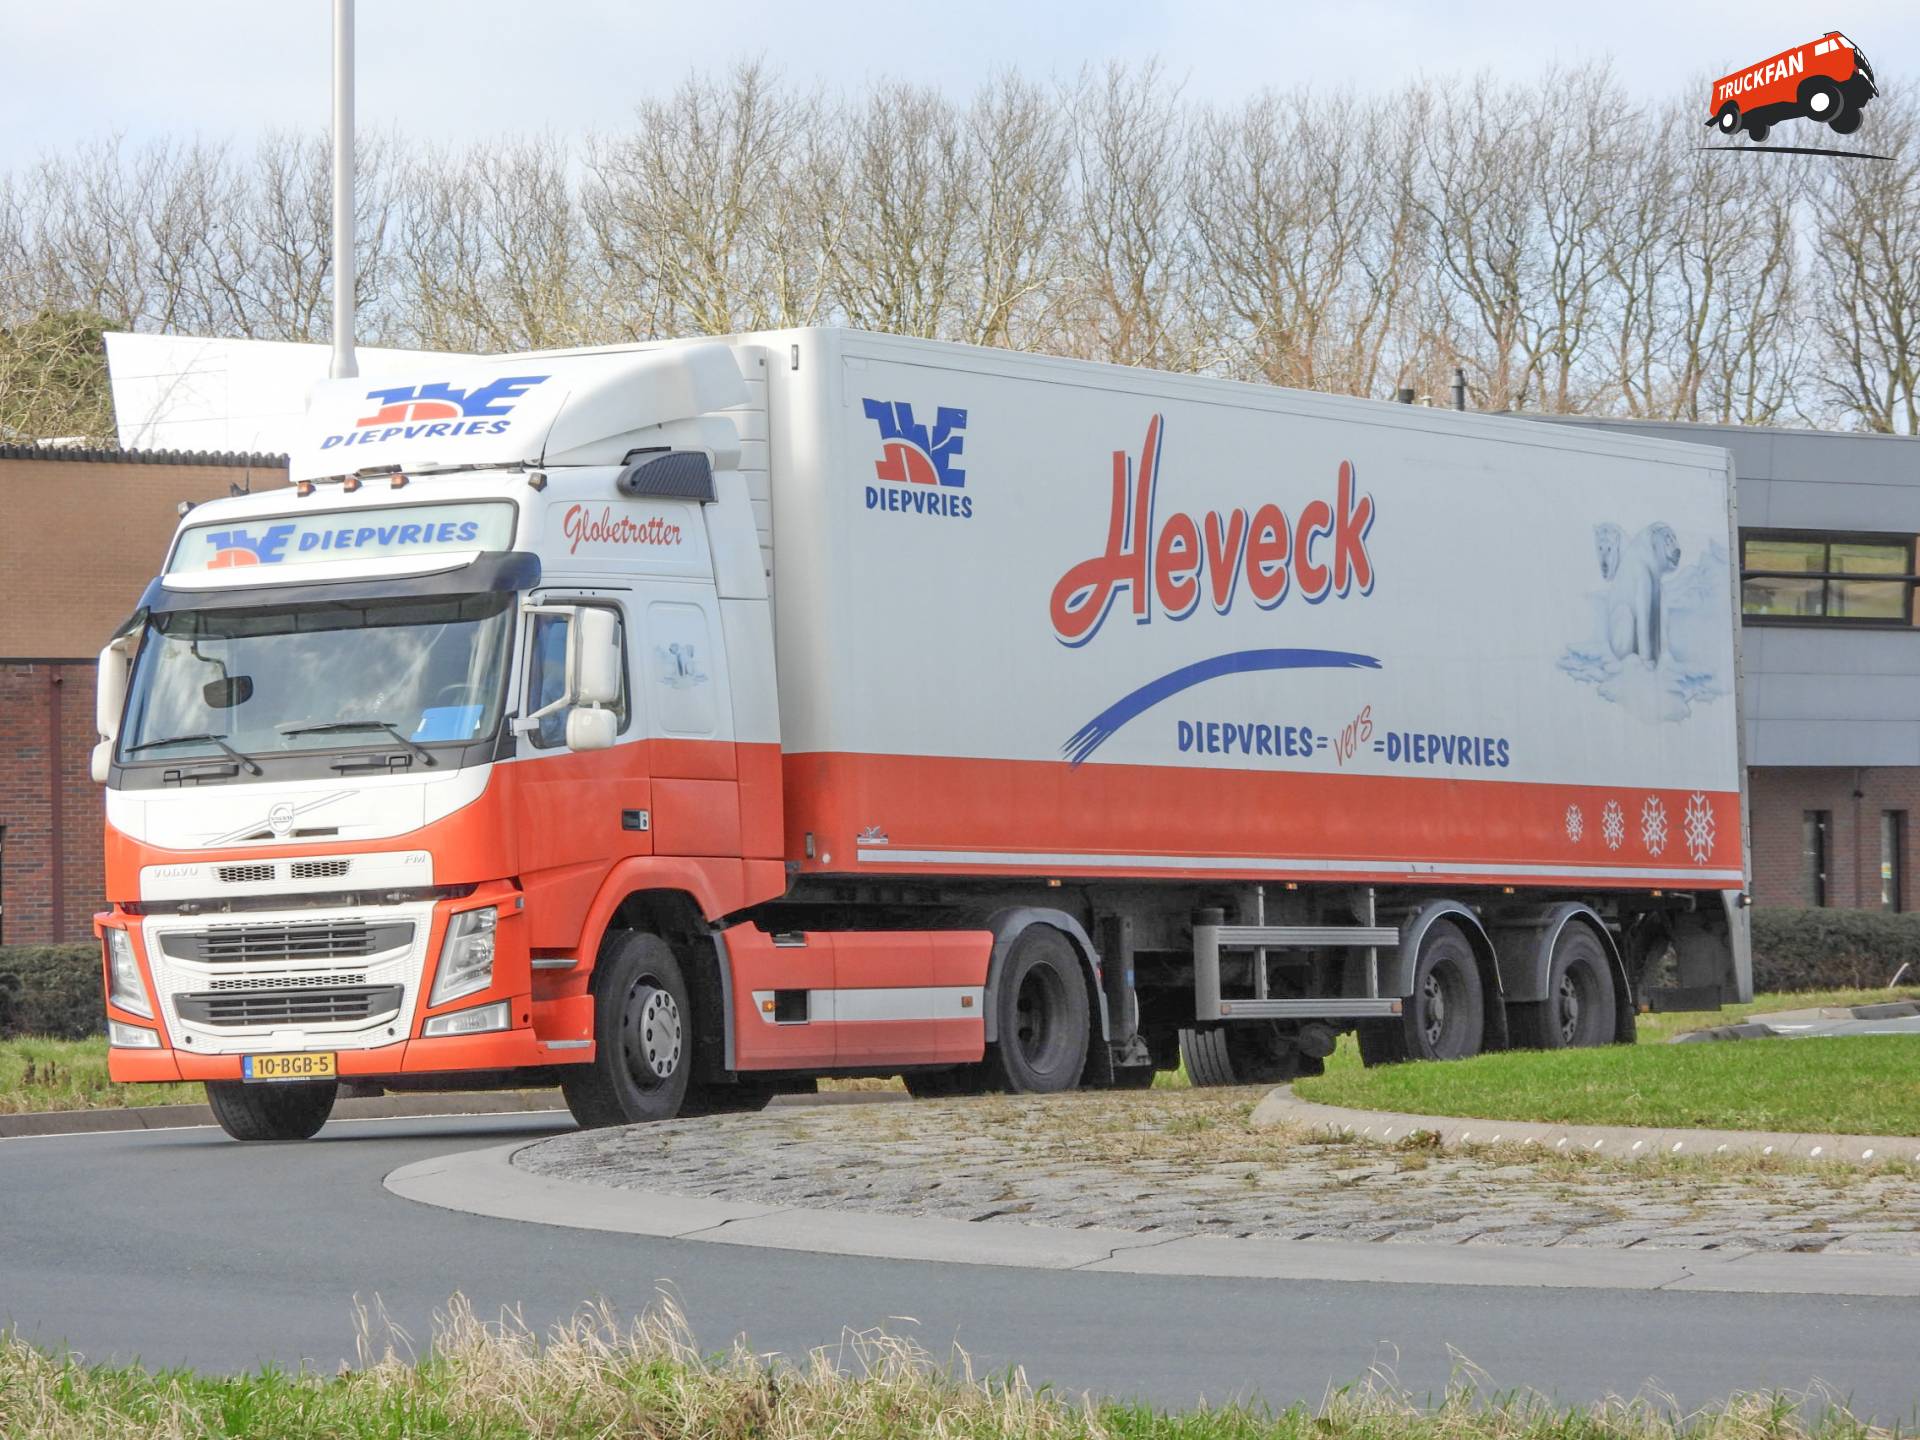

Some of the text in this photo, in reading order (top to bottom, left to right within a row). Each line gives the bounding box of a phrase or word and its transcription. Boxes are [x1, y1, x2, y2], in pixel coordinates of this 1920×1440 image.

[319, 420, 511, 450] DIEPVRIES
[865, 486, 973, 519] DIEPVRIES
[298, 521, 480, 551] DIEPVRIES
[563, 504, 682, 555] Globetrotter
[1050, 412, 1375, 648] Heveck
[1333, 705, 1373, 767] vers
[258, 1056, 329, 1075] 10-BGB-5
